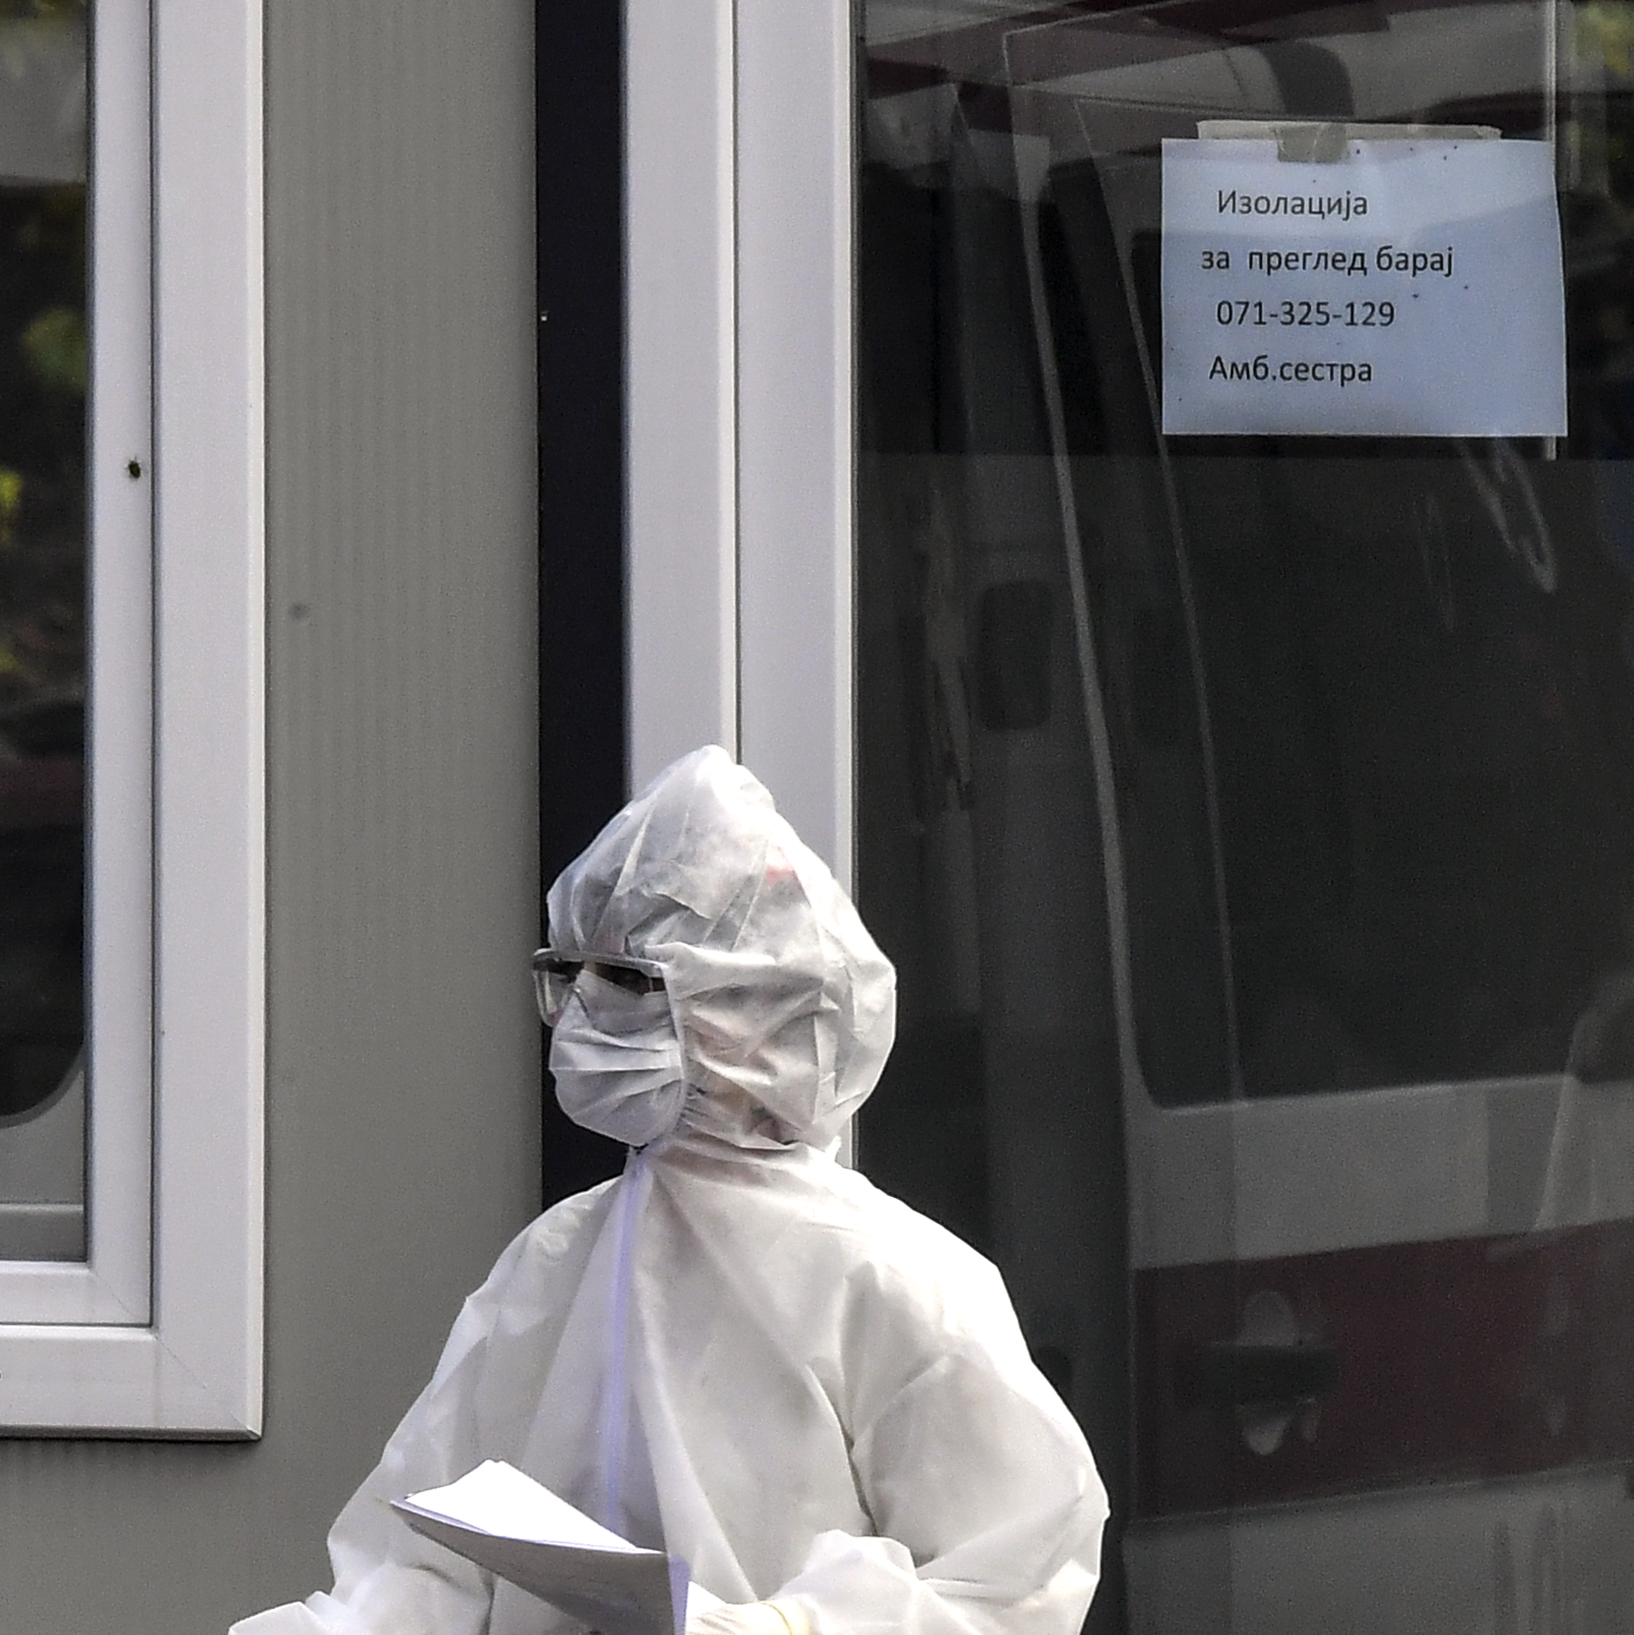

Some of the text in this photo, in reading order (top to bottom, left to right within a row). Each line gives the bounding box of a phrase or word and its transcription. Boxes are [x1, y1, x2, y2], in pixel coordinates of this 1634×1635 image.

[1217, 189, 1368, 221] Изолација
[1201, 245, 1455, 277] за преглед барај
[1216, 300, 1396, 327] 071-325-129
